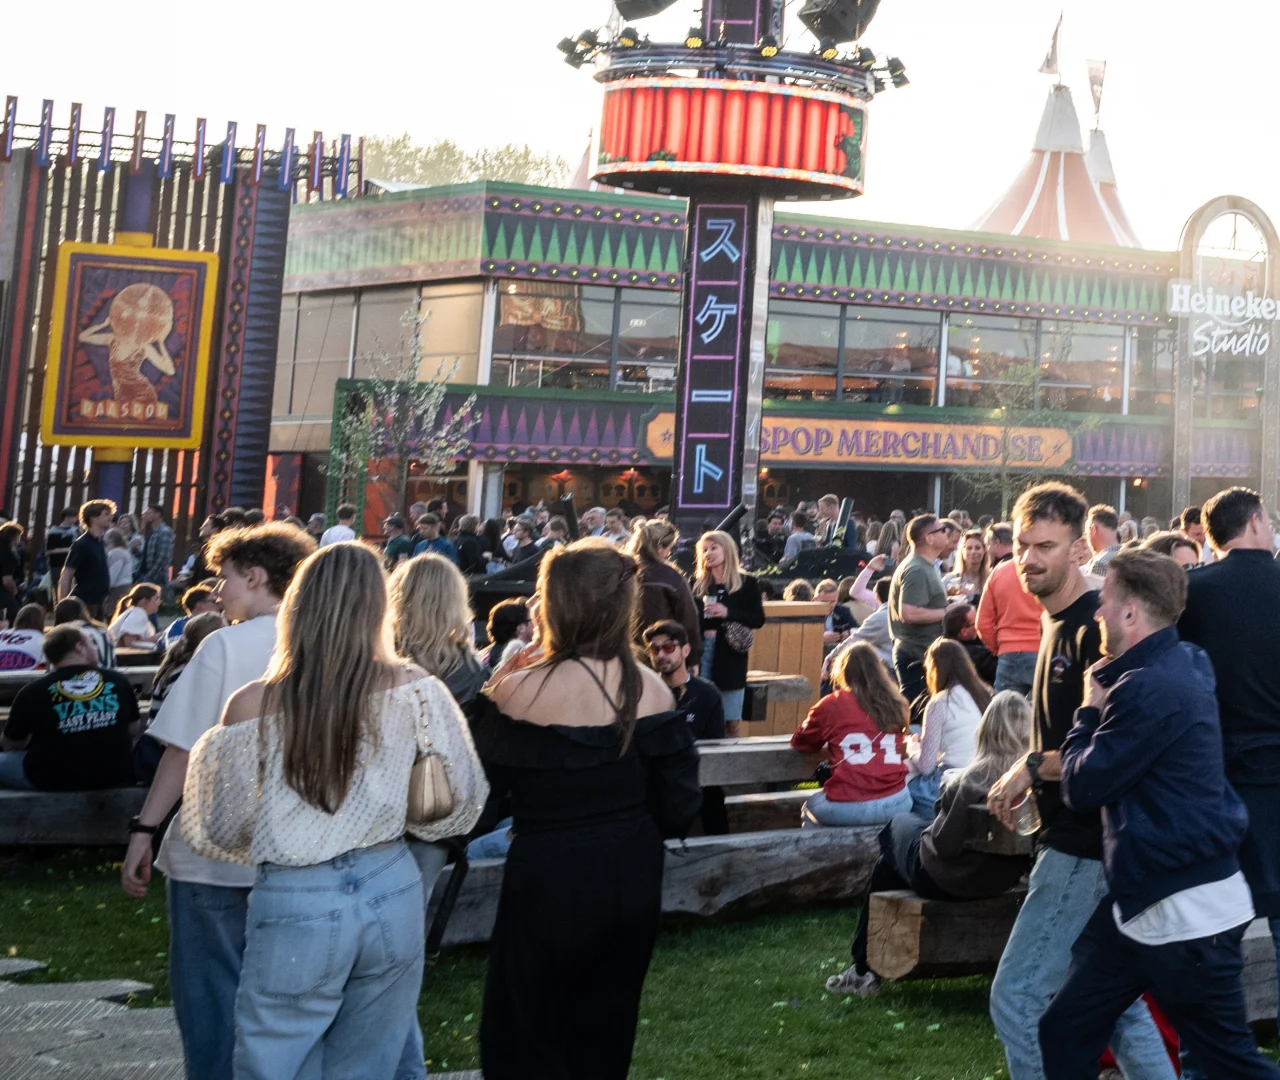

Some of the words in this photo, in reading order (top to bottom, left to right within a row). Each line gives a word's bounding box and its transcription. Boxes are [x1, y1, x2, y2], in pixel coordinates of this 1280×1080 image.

[692, 218, 741, 495] スケート
[1192, 320, 1271, 357] Studio
[83, 400, 167, 420] PAASPOP
[760, 425, 832, 454] SPOP
[836, 428, 1043, 461] MERCHANDSE
[53, 694, 119, 719] VANS
